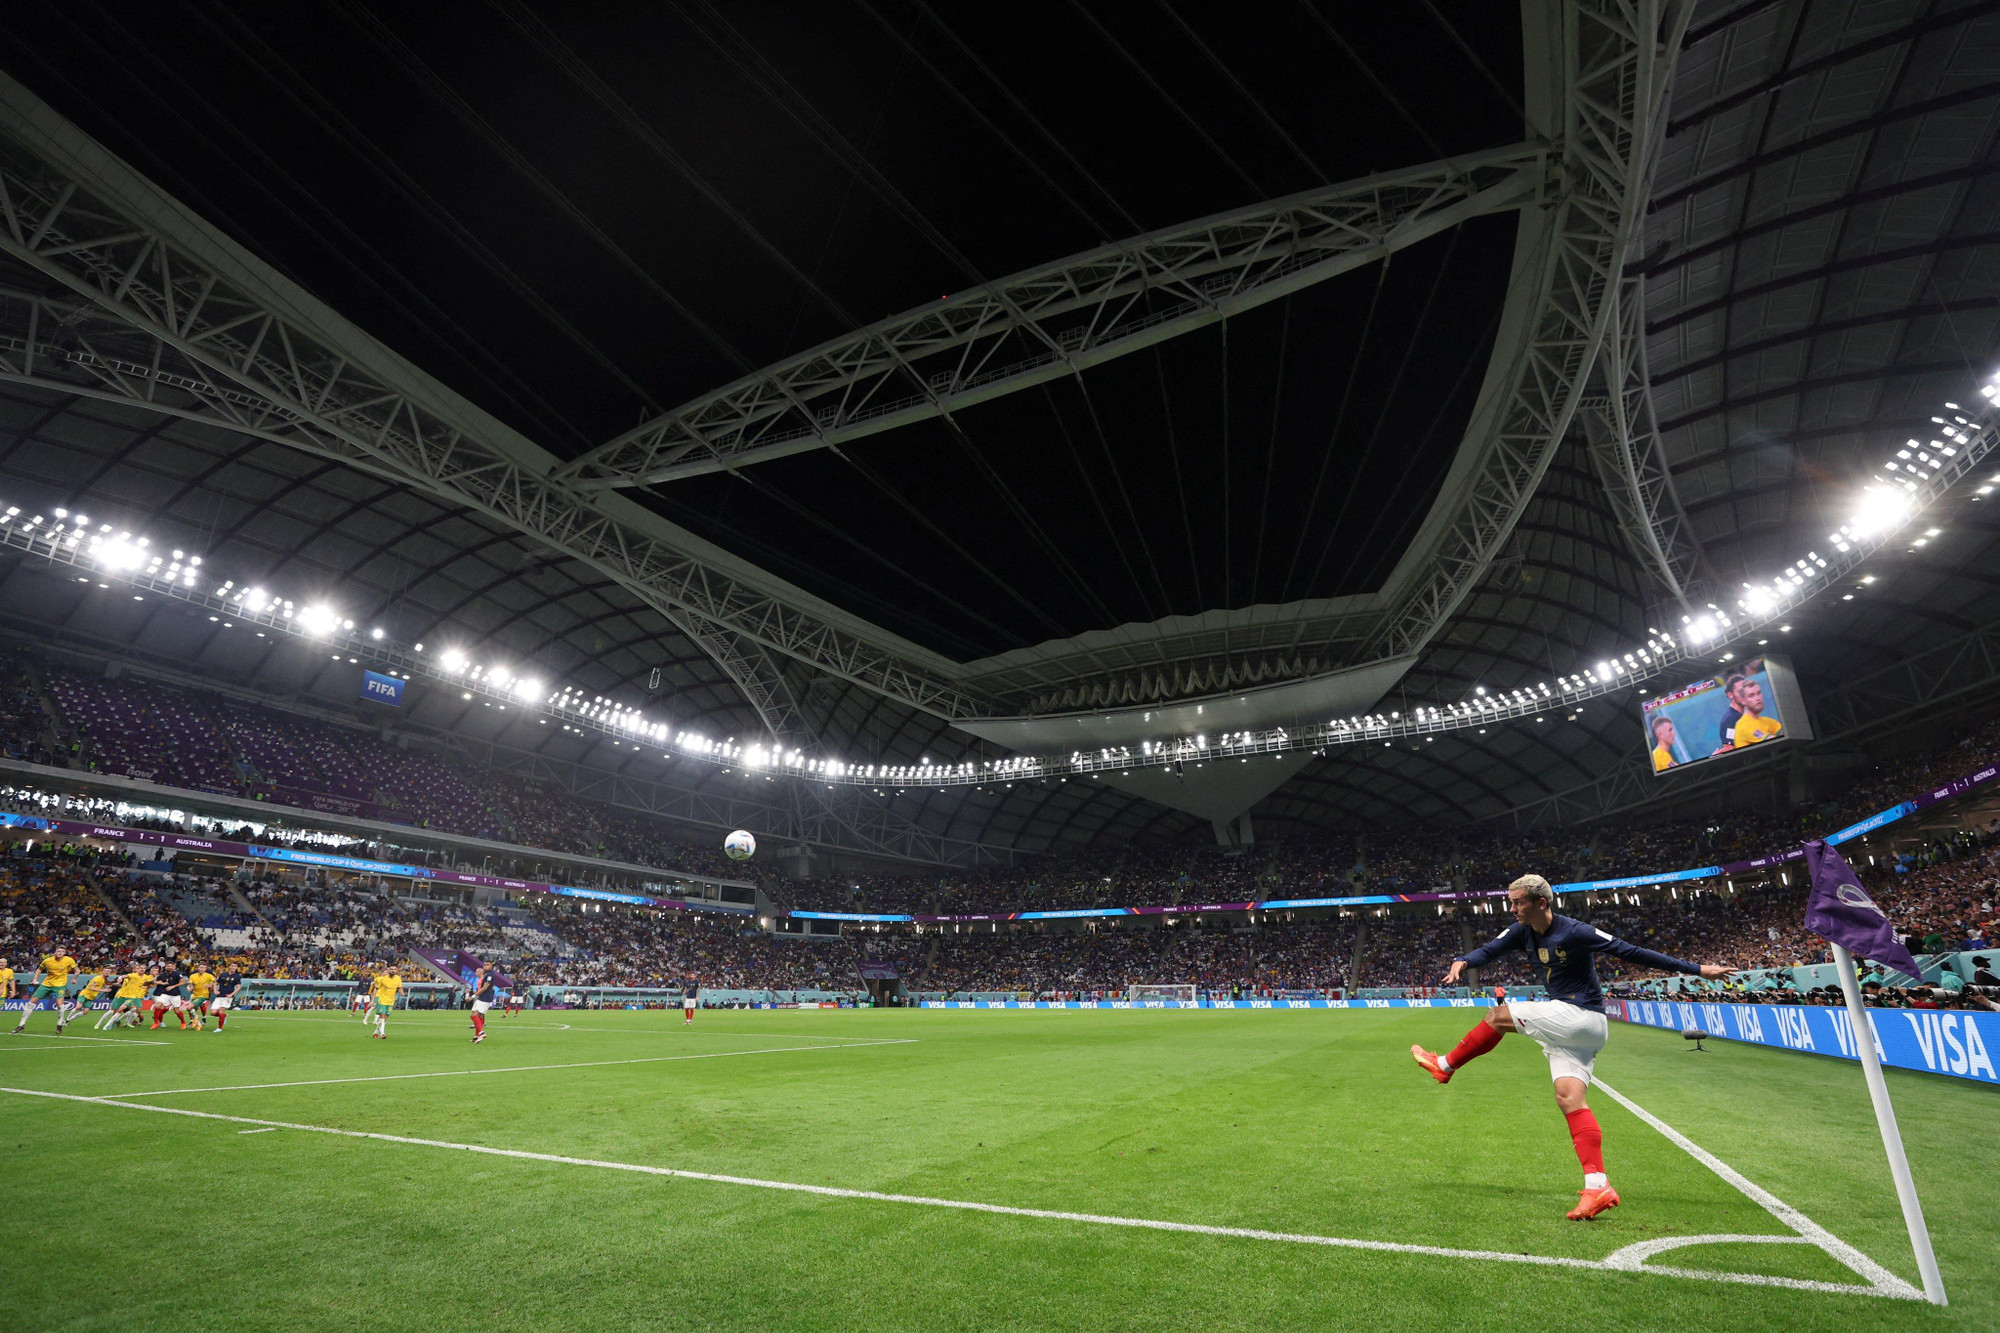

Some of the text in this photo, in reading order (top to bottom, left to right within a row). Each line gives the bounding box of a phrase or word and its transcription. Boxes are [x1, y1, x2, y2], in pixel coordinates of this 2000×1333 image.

[368, 680, 396, 697] FIFA
[1933, 788, 1949, 799] FRANCE
[1953, 782, 1958, 791] 1
[1964, 778, 1969, 786] 1
[1973, 767, 1996, 782] AUSTRALIA
[326, 798, 348, 806] WORLD
[94, 828, 126, 837] FRANCE
[176, 838, 212, 848] AUSTRALIA
[306, 855, 330, 863] WORLD
[1787, 850, 1804, 858] AUSTRALIA
[1541, 966, 1552, 984] 7
[1144, 1000, 1164, 1008] VISA
[1179, 1000, 1199, 1008] VISA
[1213, 1000, 1235, 1008] VISA
[1250, 1000, 1272, 1008] VISA
[1287, 1000, 1310, 1008] VISA
[1326, 1000, 1350, 1008] VISA
[1365, 1000, 1390, 1008] VISA
[1406, 999, 1432, 1008] VISA
[1448, 998, 1475, 1008] VISA
[1628, 1002, 1641, 1023] VISA
[1641, 1002, 1656, 1025] VISA
[1657, 1003, 1674, 1028] VISA
[1676, 1004, 1698, 1030] VISA
[1700, 1004, 1727, 1036] VISA
[1730, 1006, 1764, 1042] VISA
[1770, 1007, 1815, 1050] VISA
[1825, 1010, 1888, 1062] VIA
[1902, 1012, 1998, 1080] VISA
